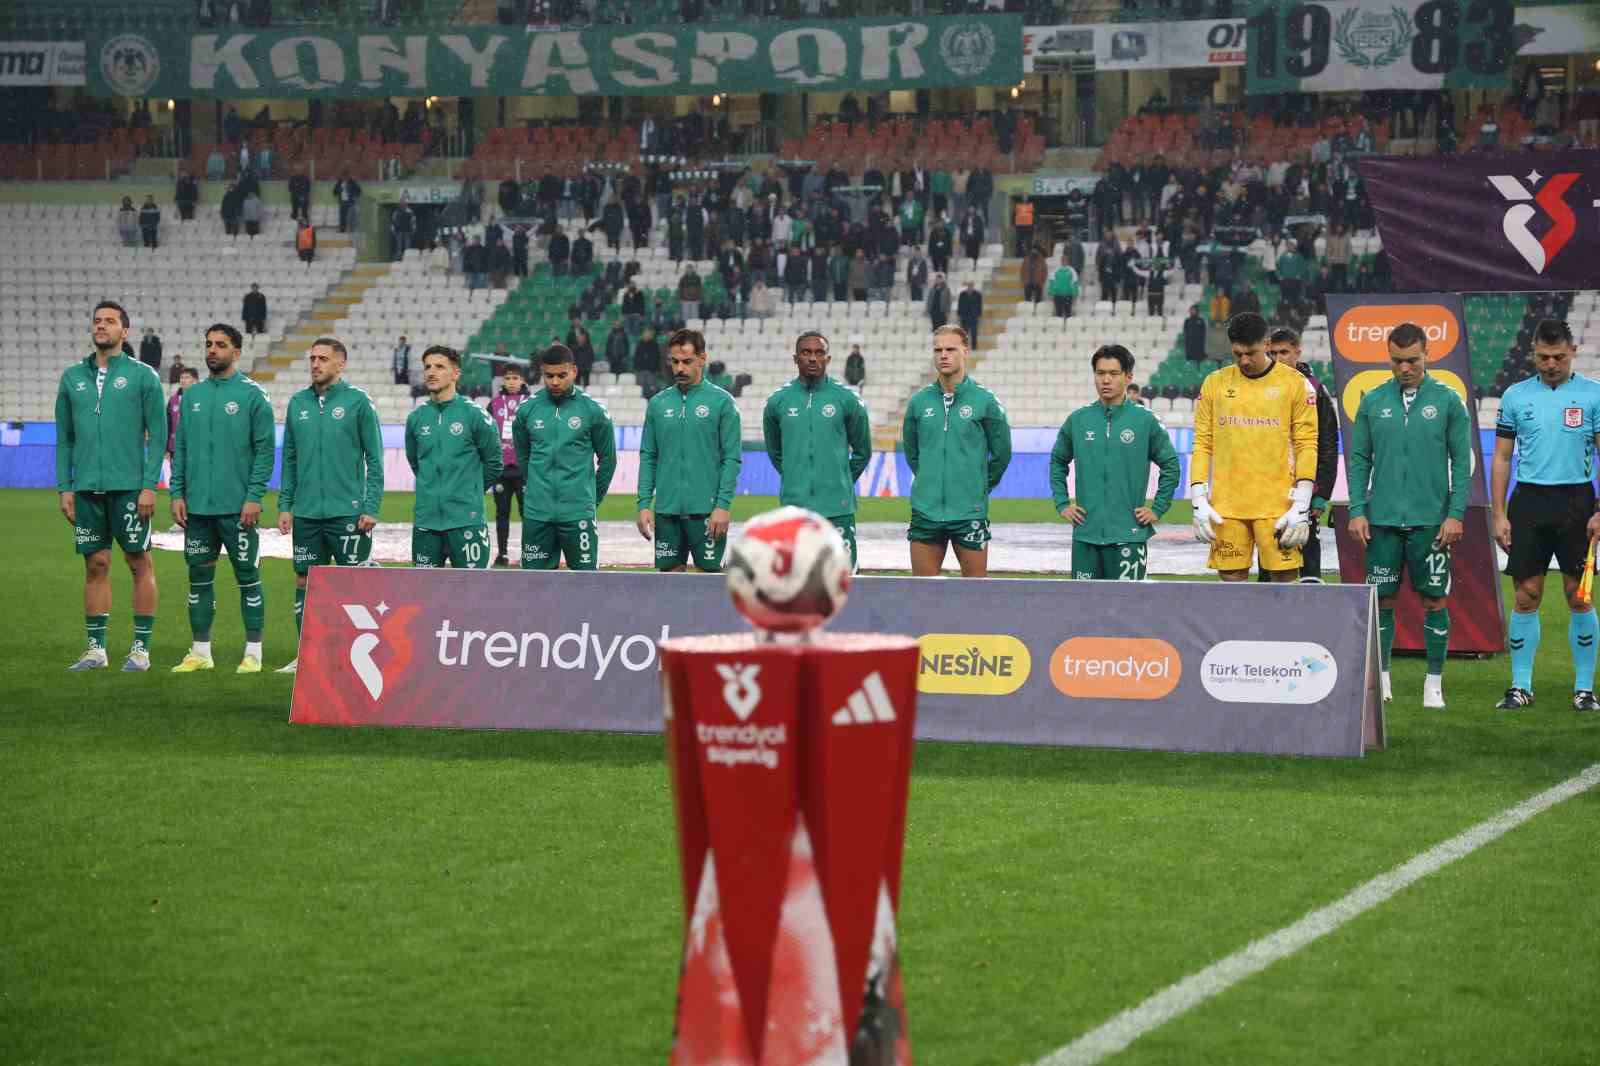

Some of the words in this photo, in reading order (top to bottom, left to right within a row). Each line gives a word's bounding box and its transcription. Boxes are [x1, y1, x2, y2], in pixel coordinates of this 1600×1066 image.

[1247, 4, 1331, 78] 19
[1411, 1, 1515, 75] 83
[189, 23, 928, 95] KONYASPOR
[1347, 321, 1448, 342] trenol
[238, 532, 249, 551] 5
[340, 534, 361, 554] 77
[580, 531, 590, 551] 8
[462, 542, 481, 562] 10
[1118, 560, 1140, 581] 21
[1425, 553, 1447, 575] 12
[1063, 654, 1169, 682] trendyol
[1208, 663, 1239, 677] Türk
[1242, 664, 1302, 679] Telekom
